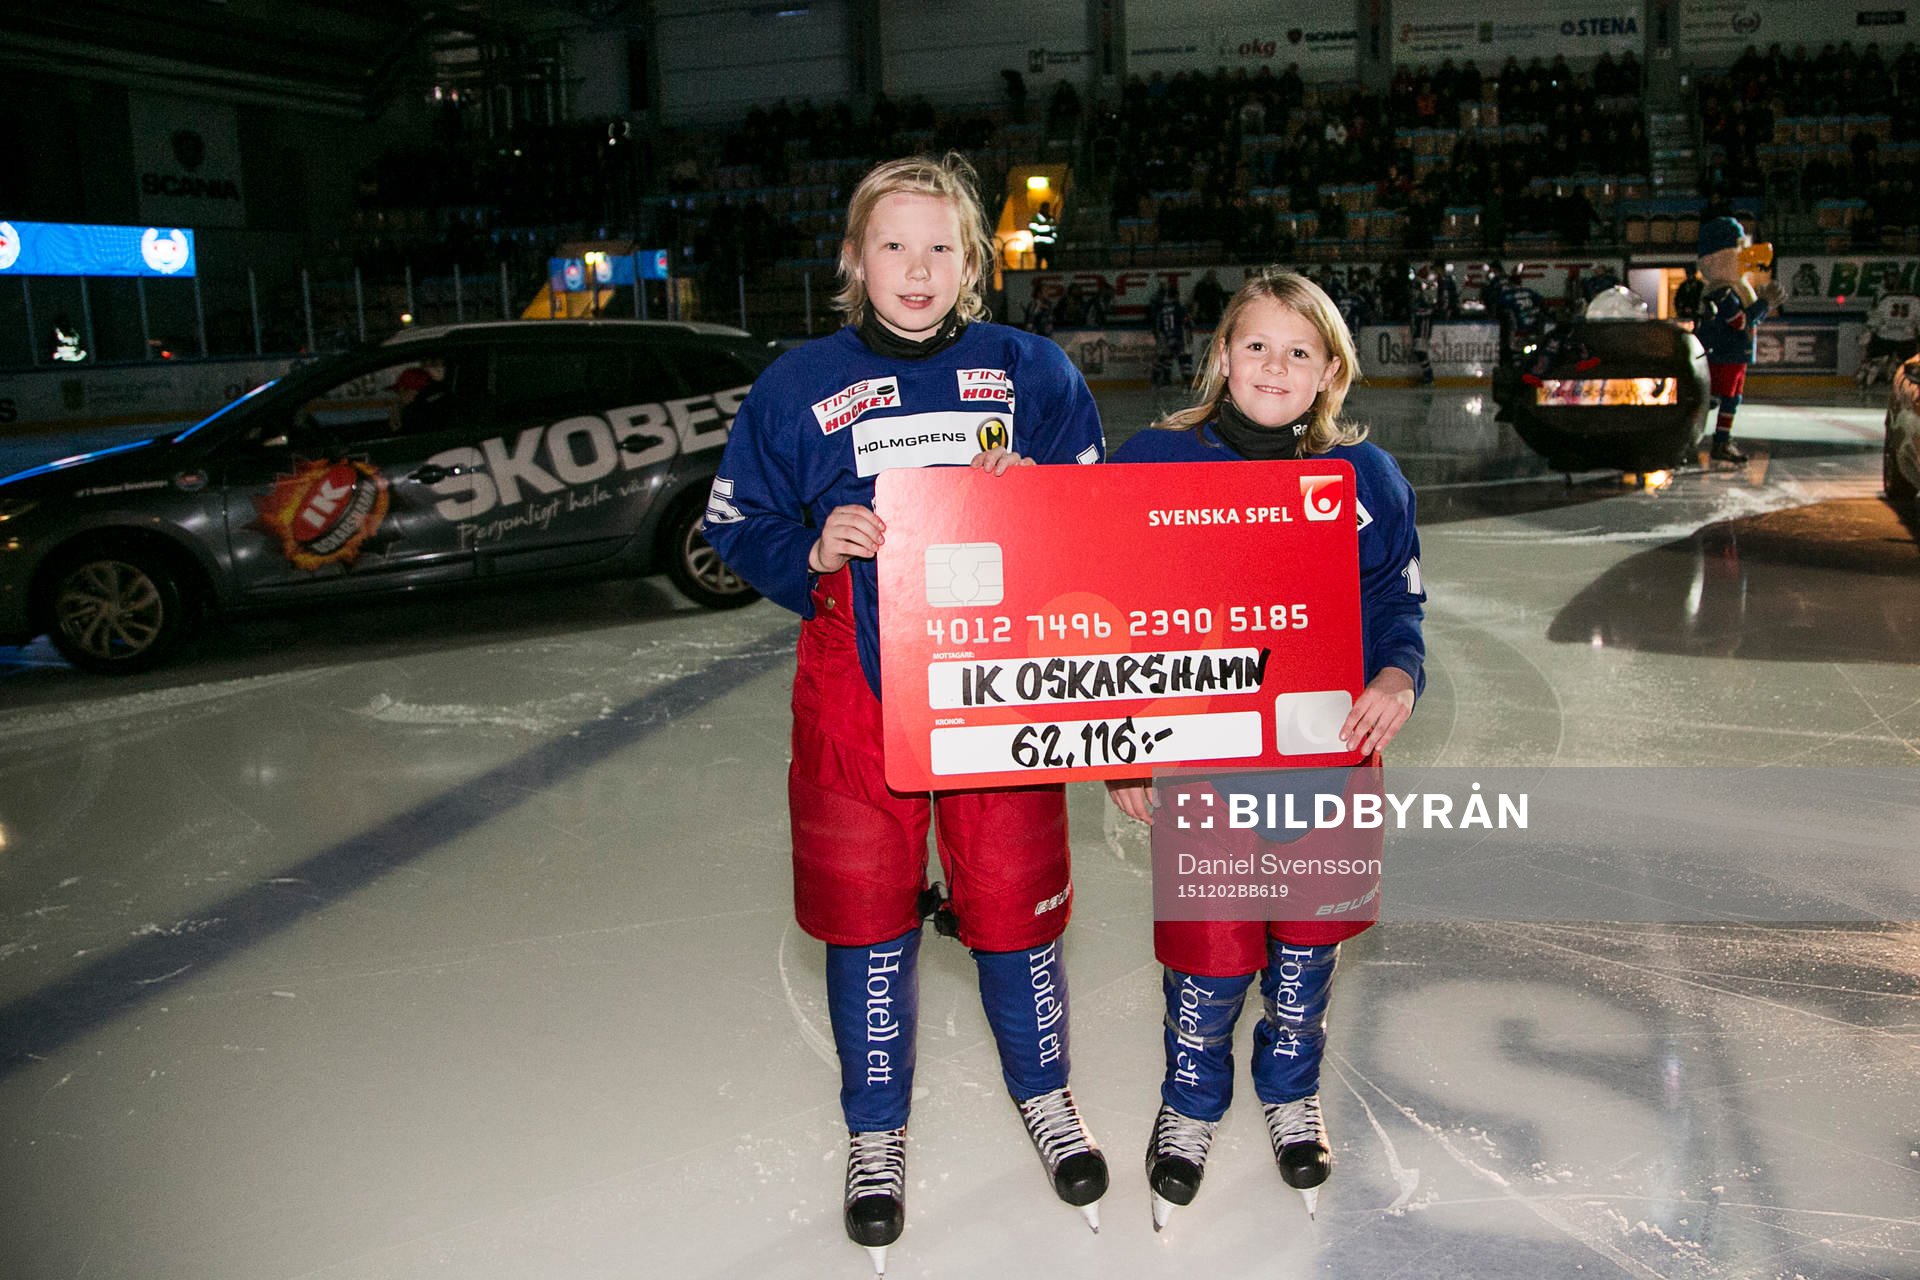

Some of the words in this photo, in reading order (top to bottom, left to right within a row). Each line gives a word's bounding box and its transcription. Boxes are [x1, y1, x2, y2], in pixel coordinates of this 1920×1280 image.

[1578, 17, 1637, 36] STENA
[140, 172, 240, 202] SCANIA
[962, 370, 1006, 381] TIN
[816, 381, 870, 412] TING
[962, 387, 1010, 404] HOC
[824, 394, 897, 434] HOCKEY
[857, 432, 967, 456] HOLMGRENS
[301, 480, 353, 529] IK
[1148, 506, 1241, 528] SVENSKA
[1245, 506, 1294, 524] SPEL
[456, 497, 561, 551] Personligt
[926, 616, 1012, 646] 4012
[1026, 612, 1112, 641] 7496
[1128, 608, 1213, 636] 2390
[1230, 604, 1309, 632] 5185
[962, 665, 1007, 706] IK
[1016, 647, 1272, 701] OSKARSHAMN
[866, 946, 904, 1043] Hotell
[1029, 940, 1064, 1032] Hotell
[1039, 1032, 1062, 1068] ett
[866, 1050, 894, 1087] ett
